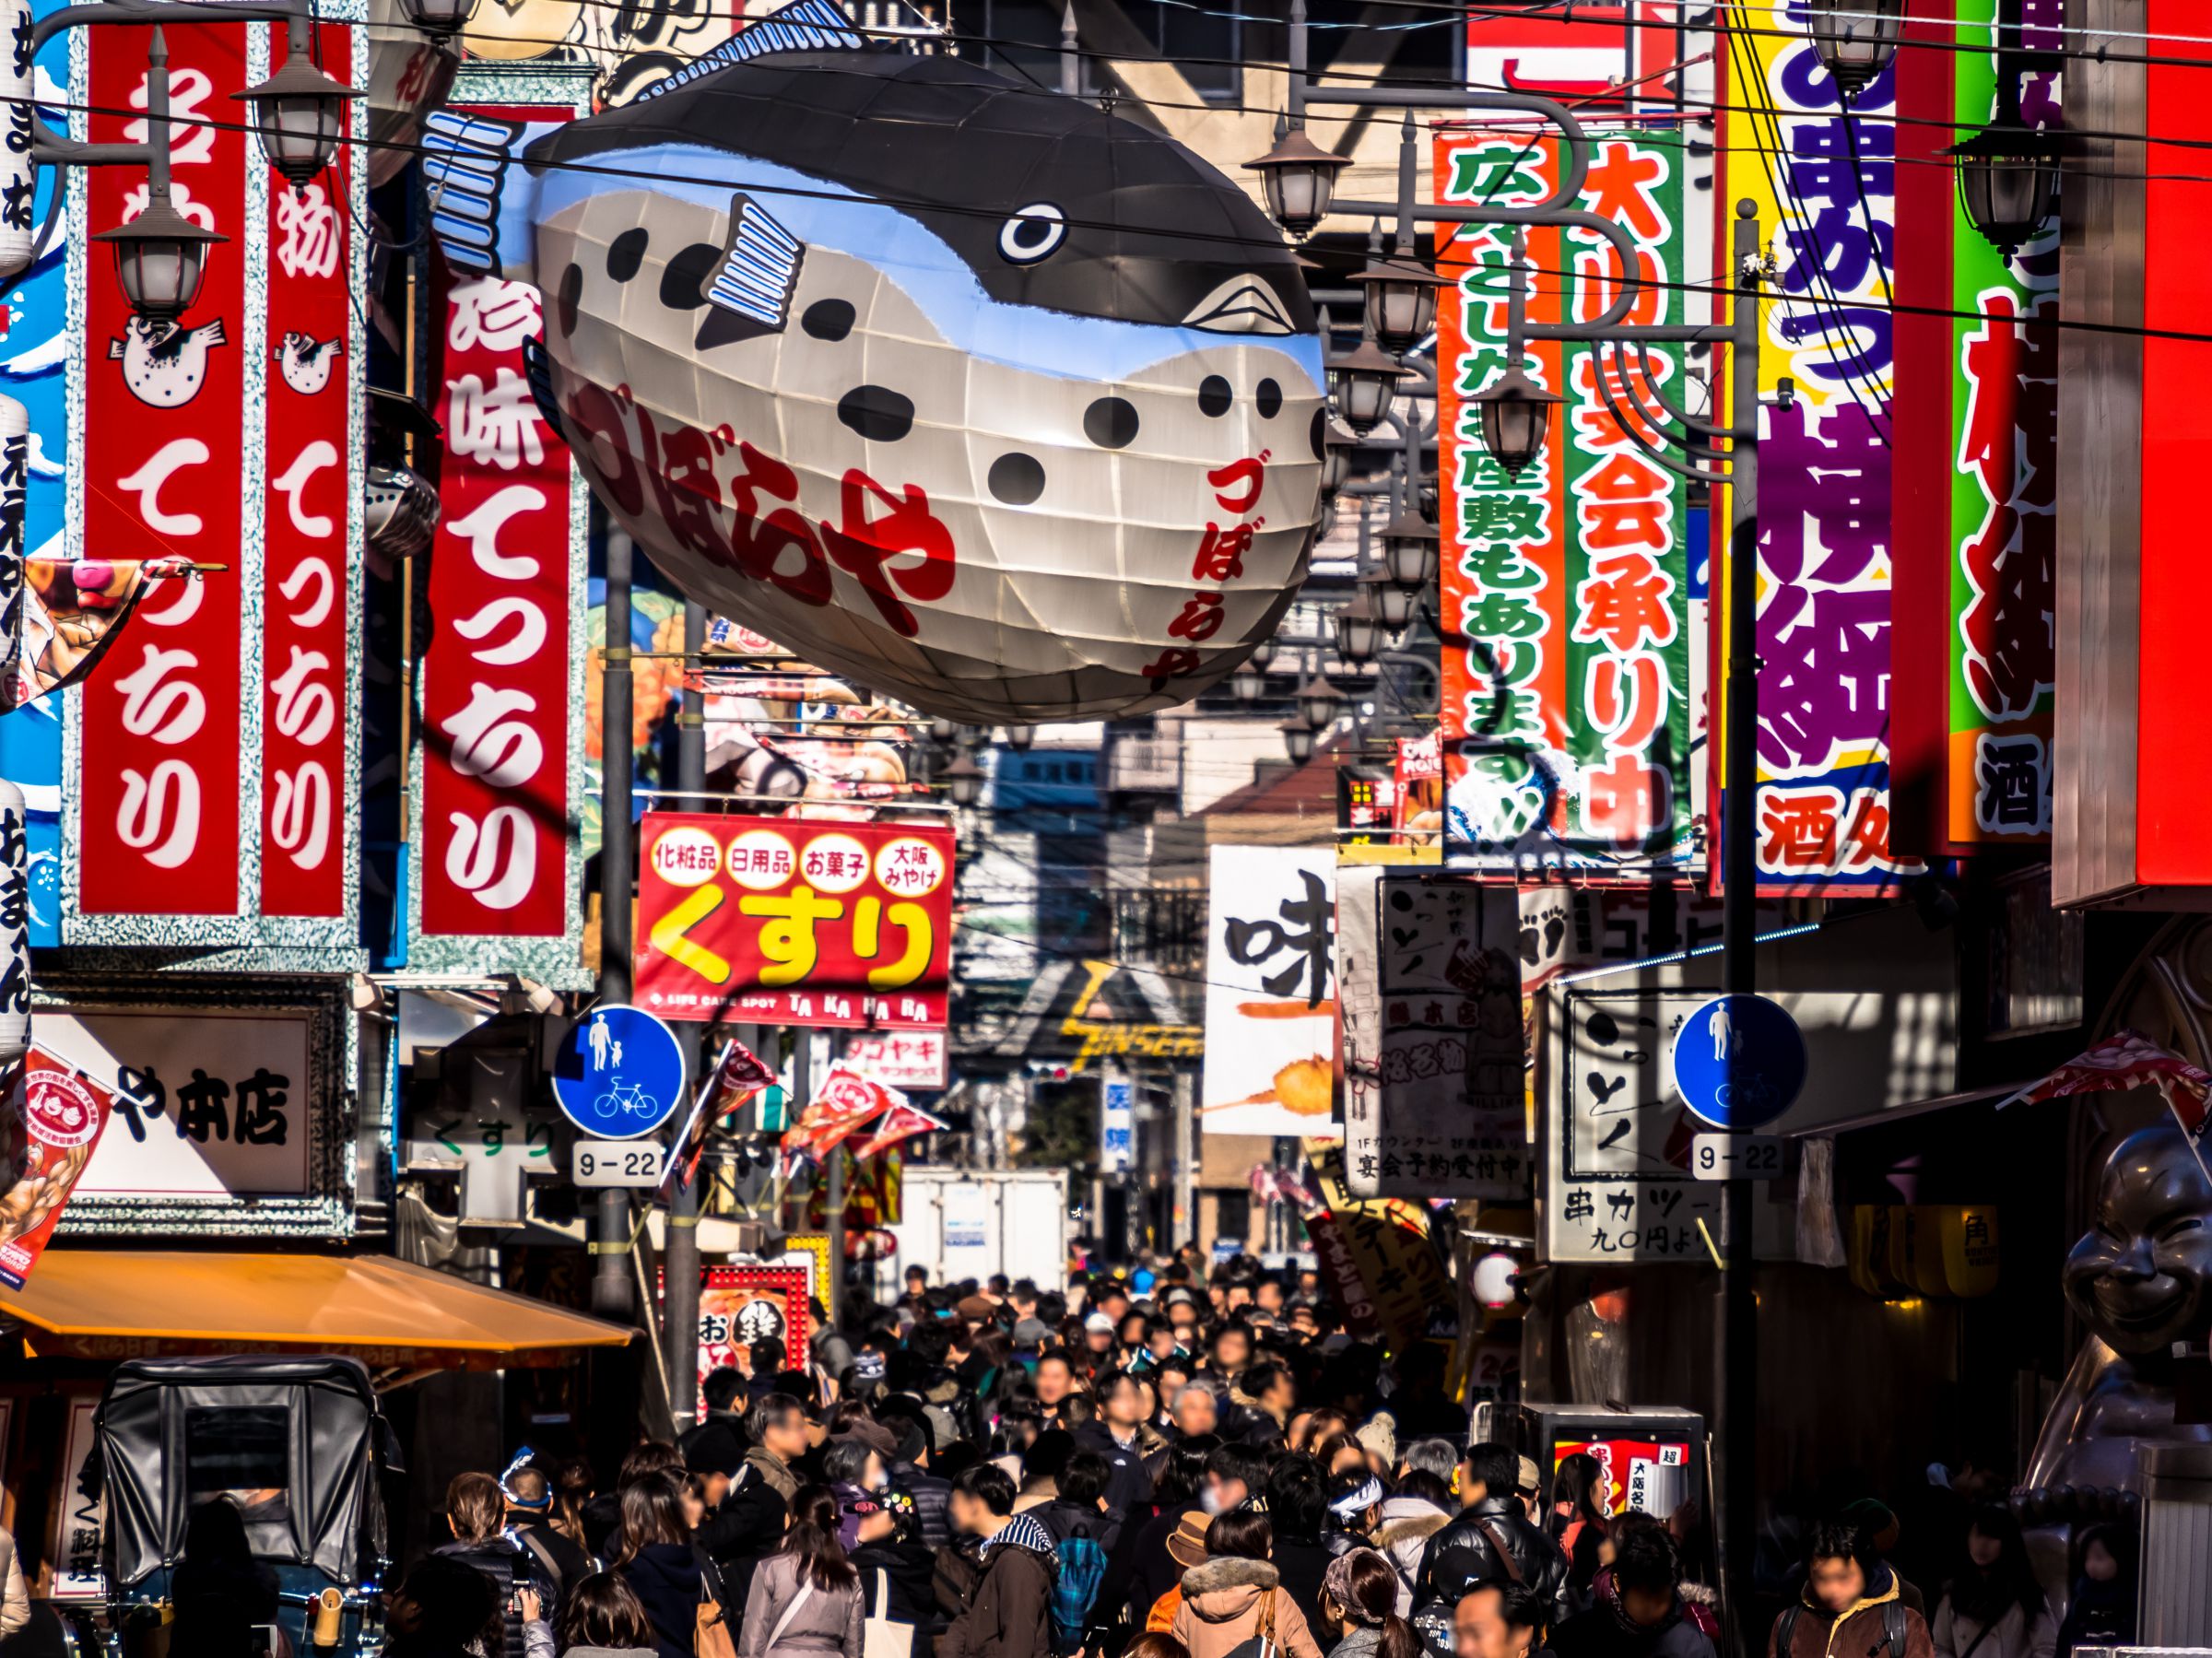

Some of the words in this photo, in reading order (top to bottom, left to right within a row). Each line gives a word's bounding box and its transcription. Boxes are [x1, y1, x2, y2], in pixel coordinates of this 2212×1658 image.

[566, 382, 957, 637] づぼらや
[1142, 448, 1272, 692] づぼらや
[1982, 743, 2054, 827] 酒
[655, 843, 717, 871] 化粧品
[731, 848, 791, 875] 日用品
[806, 851, 865, 878] お菓子
[894, 845, 928, 865] 大阪
[885, 868, 936, 889] みやげ
[651, 883, 935, 992] くすり
[667, 994, 698, 1006] LIFE
[740, 996, 777, 1009] SPOT
[846, 1037, 937, 1062] タコヤキ
[434, 1118, 555, 1158] くすり
[1356, 1155, 1521, 1180] 宴会予約受付中
[1964, 1215, 1989, 1246] 角
[1662, 1450, 1677, 1464] 超
